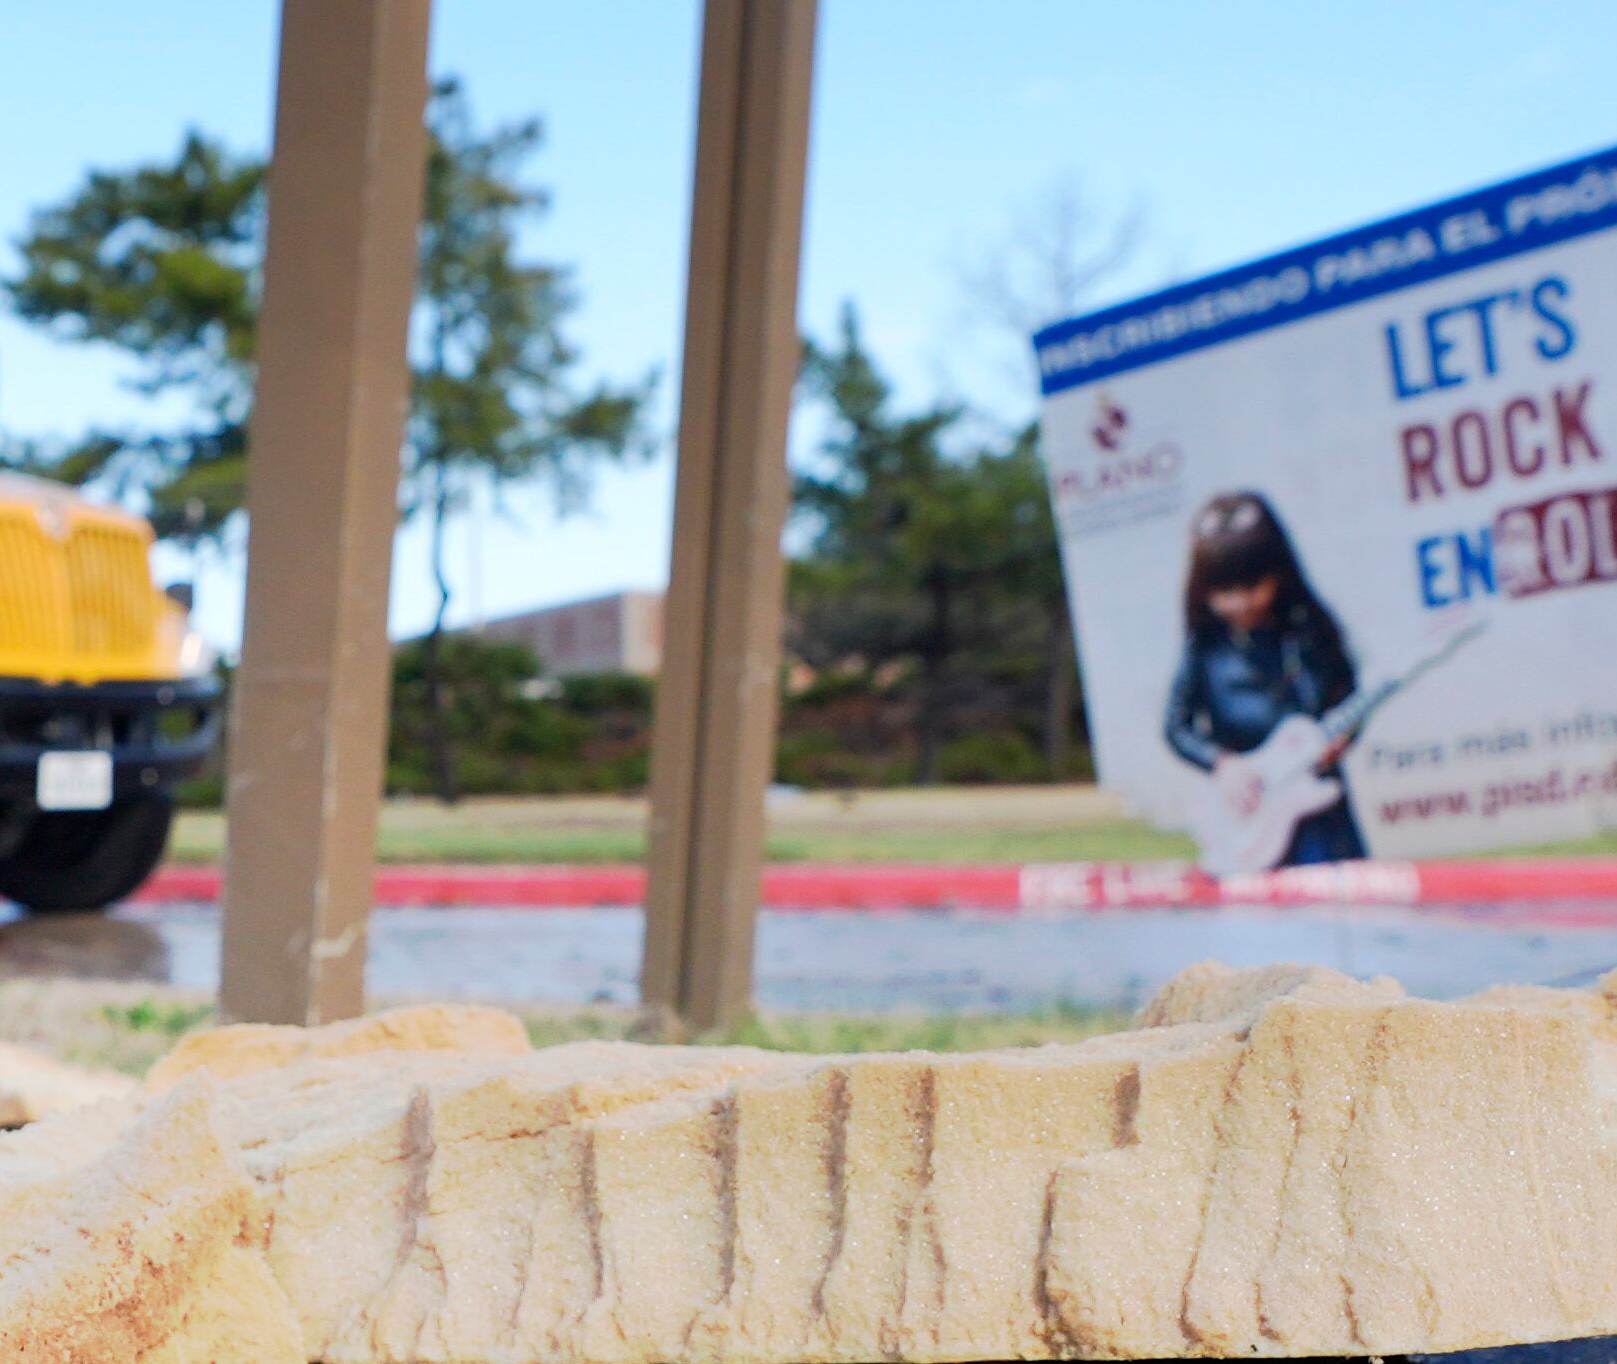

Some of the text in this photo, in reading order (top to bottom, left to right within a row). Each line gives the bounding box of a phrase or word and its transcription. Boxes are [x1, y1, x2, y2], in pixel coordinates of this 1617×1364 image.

[1313, 227, 1436, 293] PARA
[1439, 207, 1502, 255] EL
[1387, 275, 1576, 400] LET'S
[1399, 378, 1601, 504] ROCK
